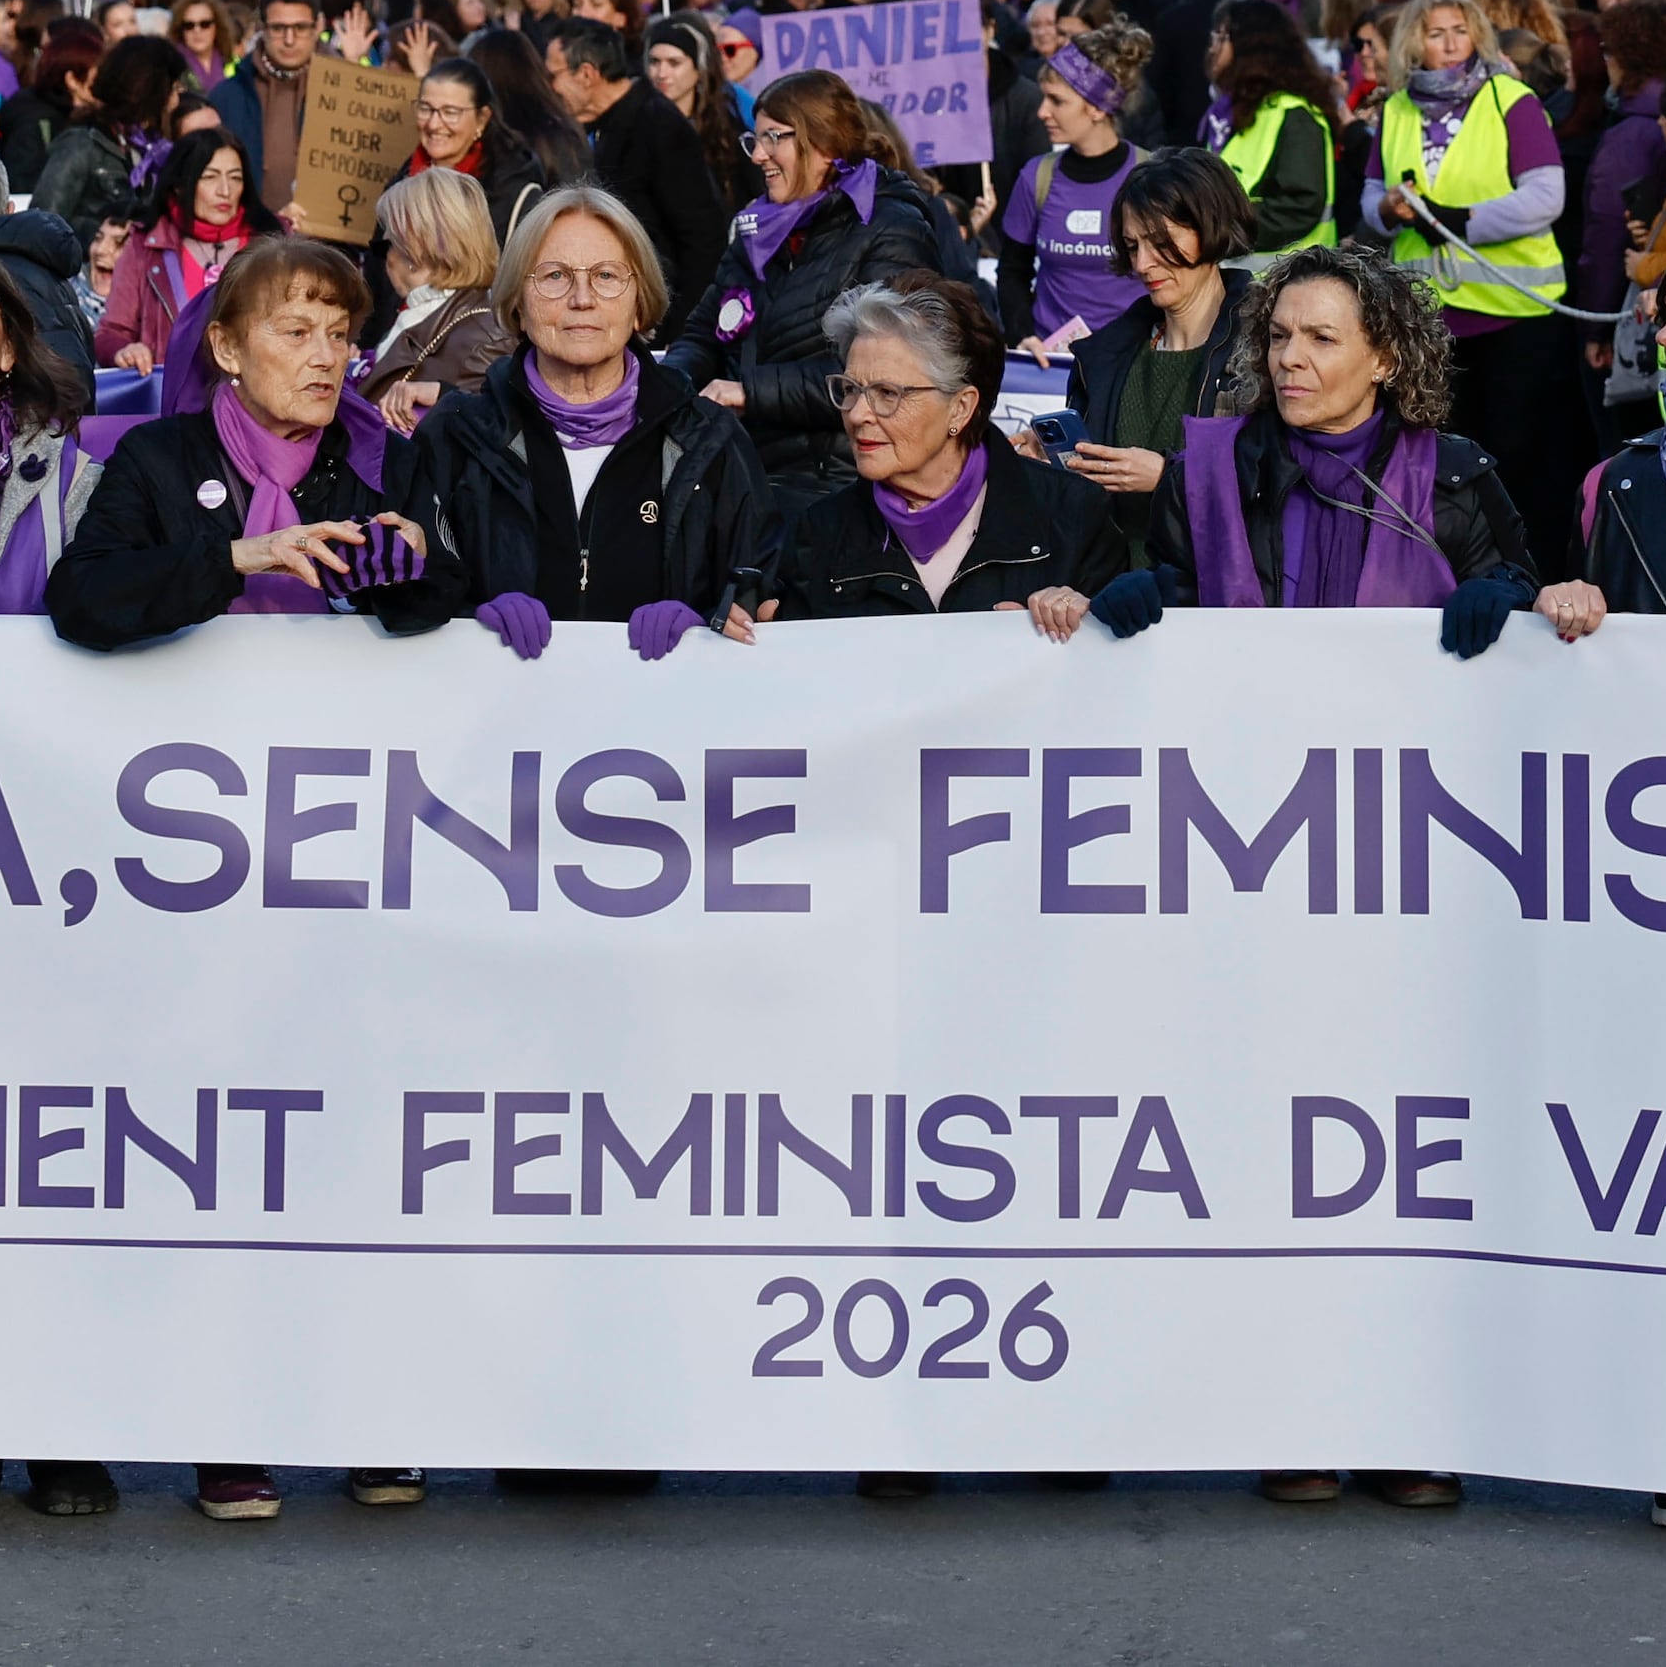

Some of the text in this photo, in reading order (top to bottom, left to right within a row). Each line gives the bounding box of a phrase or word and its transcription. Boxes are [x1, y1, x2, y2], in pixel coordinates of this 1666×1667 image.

[774, 0, 981, 70] DANIEL
[317, 94, 403, 125] NI CALLADA
[323, 70, 407, 101] NI SUMISA
[330, 126, 382, 153] MUJER
[401, 1091, 1211, 1224] FEMINISTA
[1291, 1095, 1474, 1222] DE
[752, 1277, 1070, 1383] 2026
